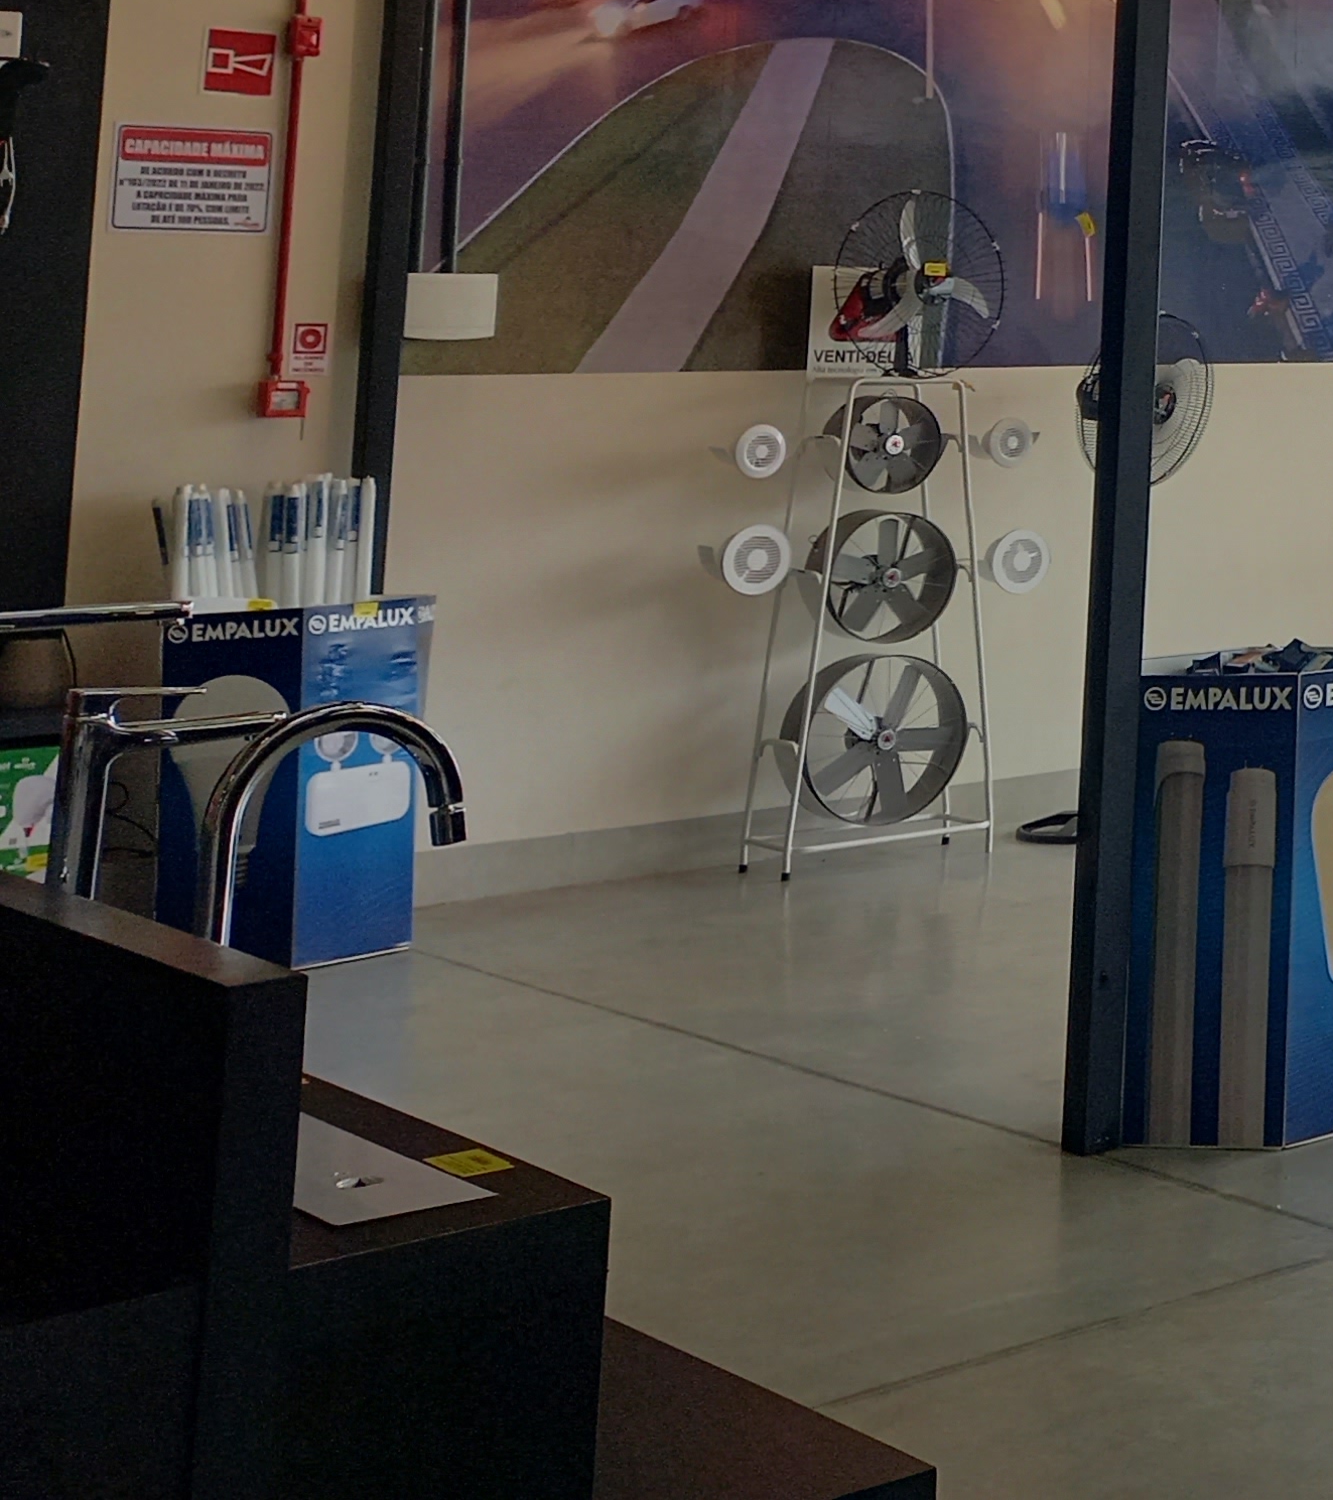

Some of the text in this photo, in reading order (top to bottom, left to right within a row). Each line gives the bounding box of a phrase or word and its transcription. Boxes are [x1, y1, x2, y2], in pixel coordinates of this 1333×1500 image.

[125, 138, 265, 160] CAPACIDADE MÁXIMA
[814, 349, 914, 364] VENTI-DELA
[192, 617, 300, 642] EMPALUX
[328, 606, 416, 633] EMPALUX
[1170, 686, 1293, 711] EMPALUX
